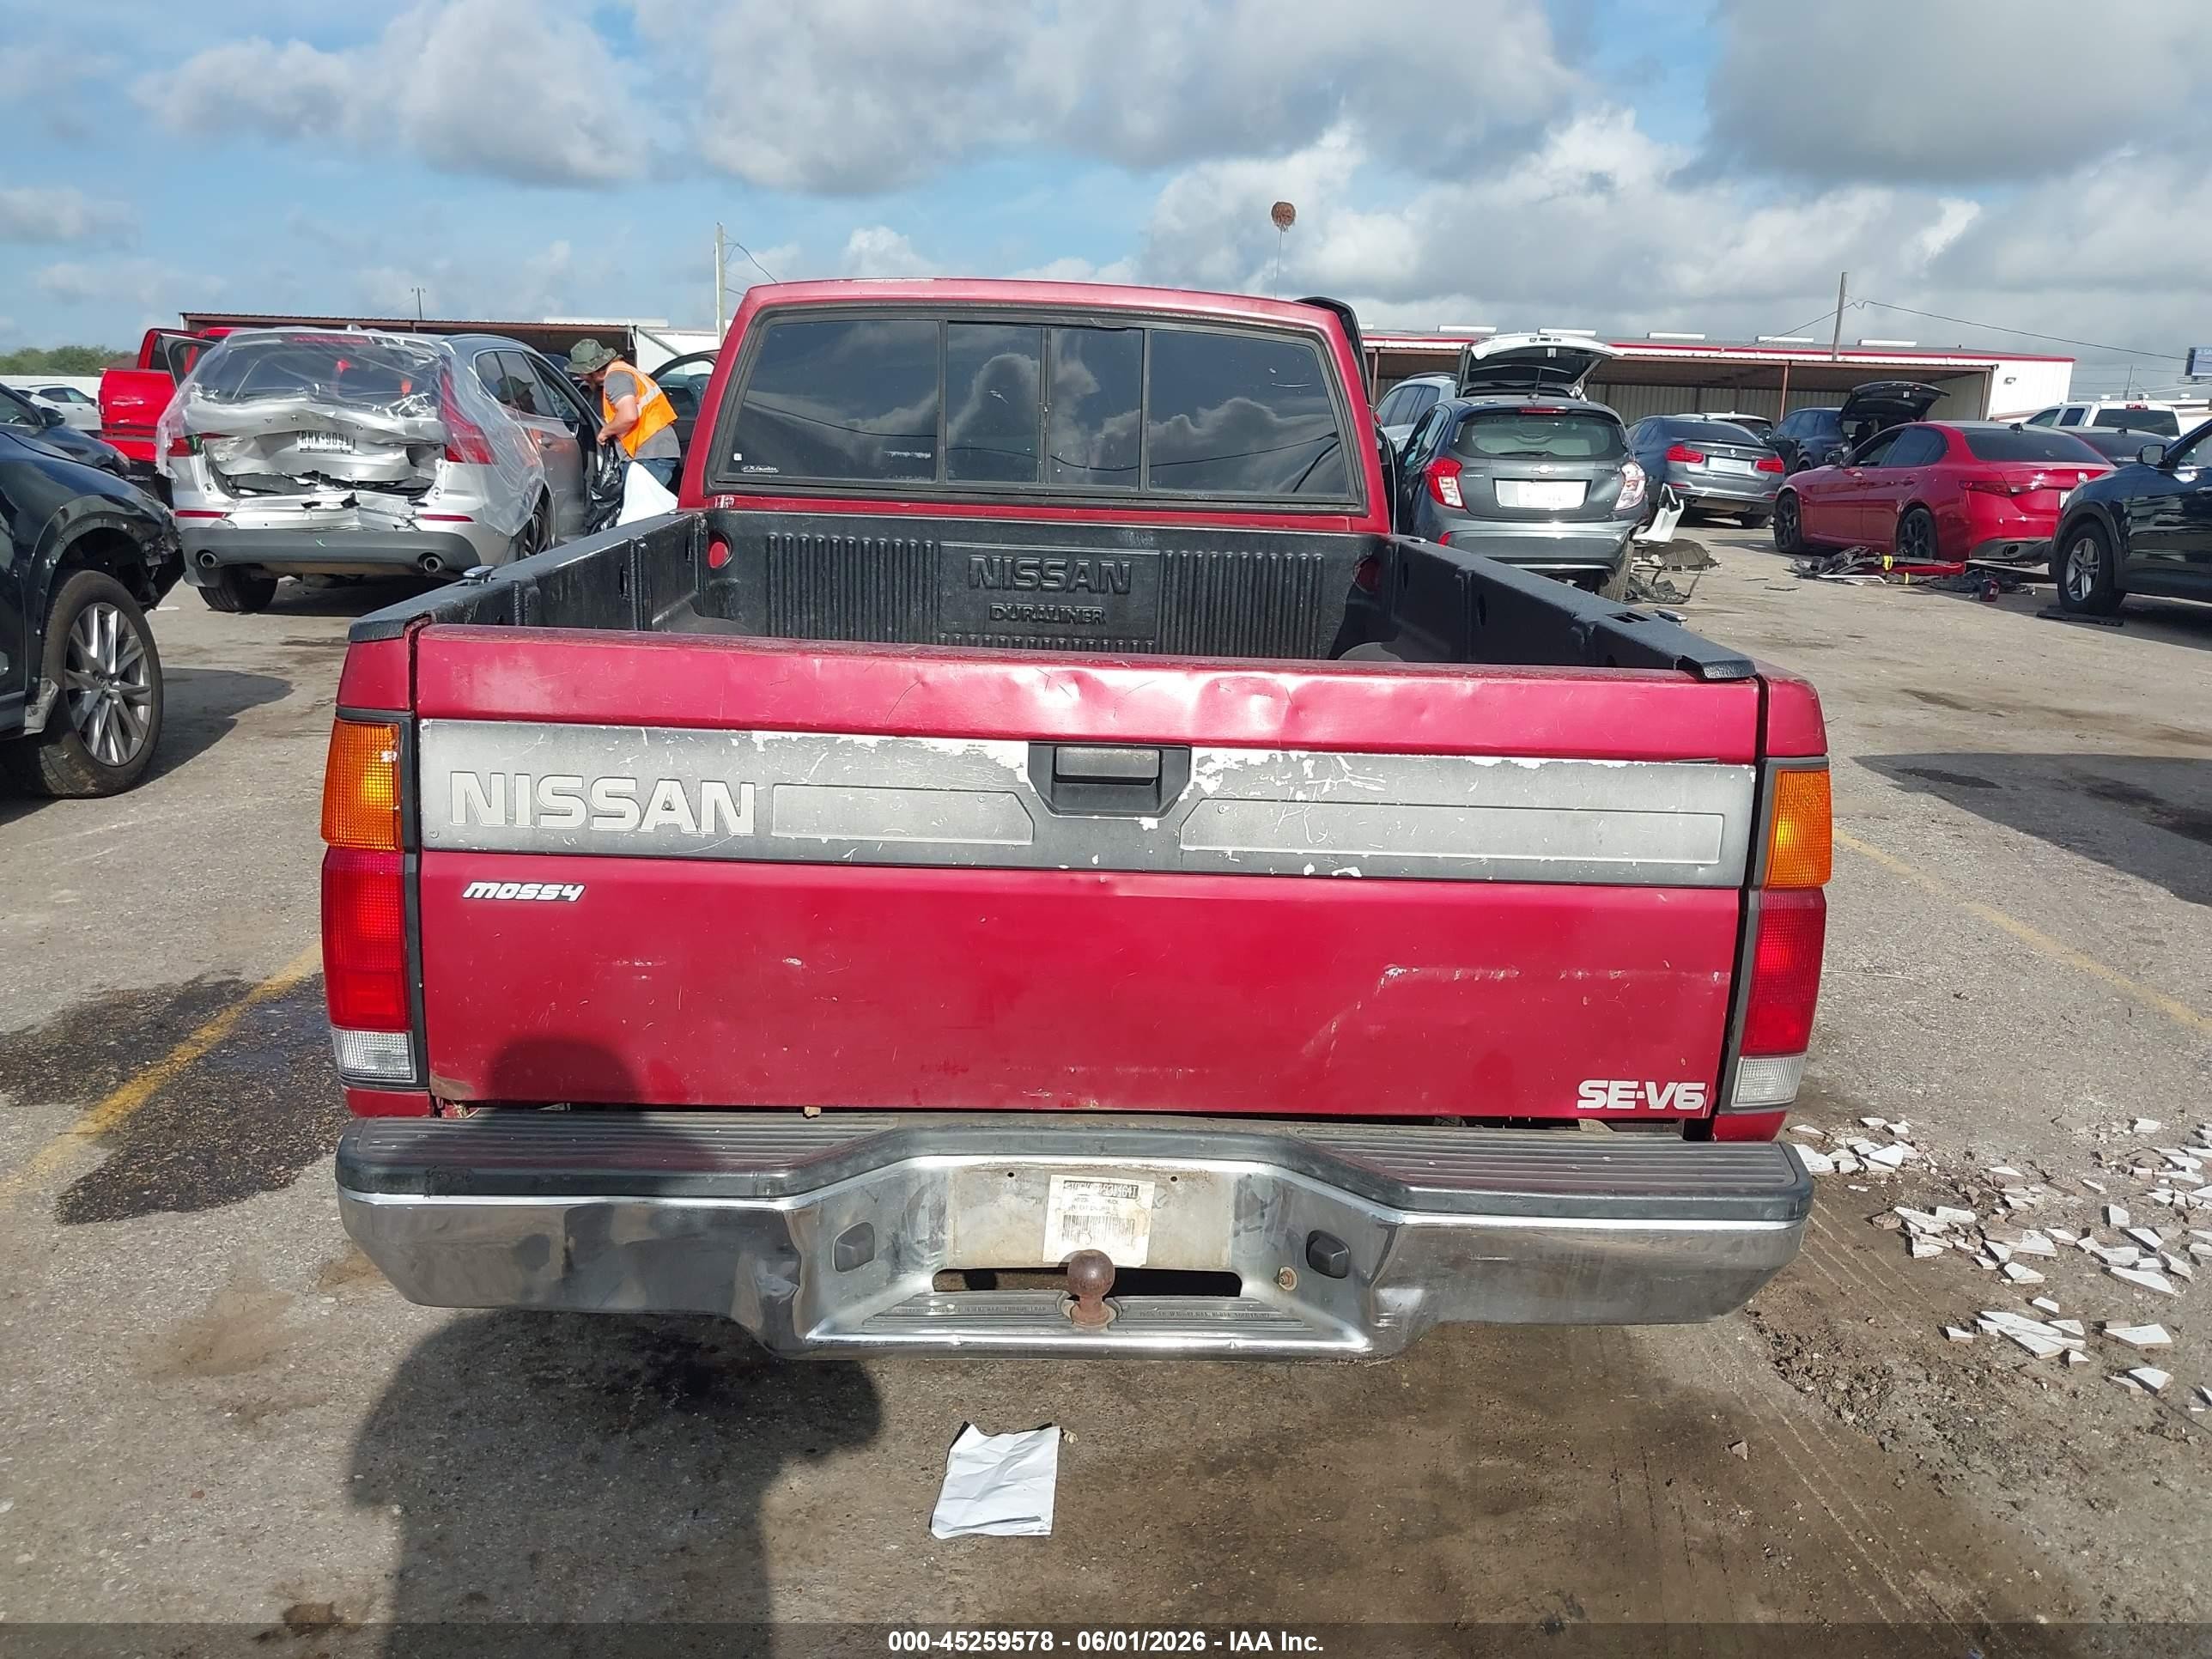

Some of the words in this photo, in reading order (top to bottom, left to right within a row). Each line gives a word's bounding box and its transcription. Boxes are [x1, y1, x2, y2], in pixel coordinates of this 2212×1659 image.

[264, 415, 363, 430] VOO
[969, 555, 1132, 594] NISSAN
[989, 603, 1106, 625] DURALINER
[450, 771, 756, 836] NISSAN
[1577, 1079, 1706, 1110] SE-V6
